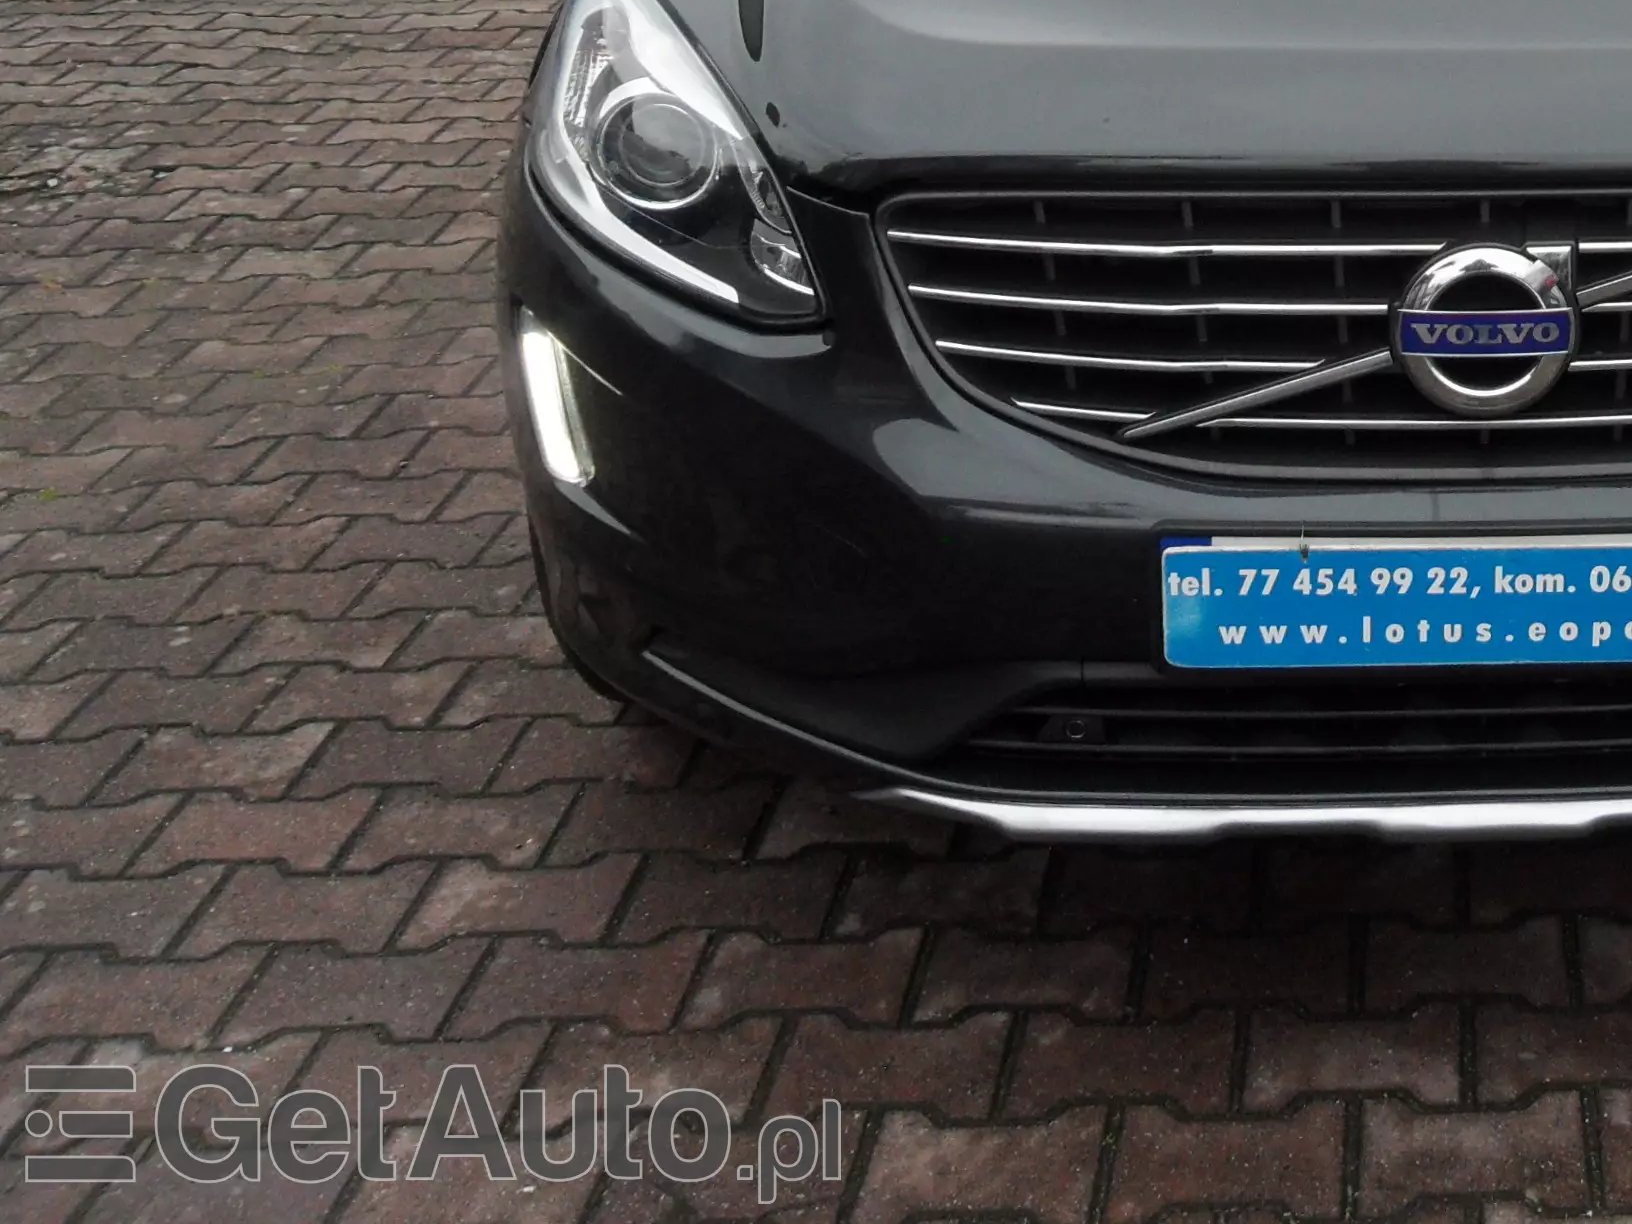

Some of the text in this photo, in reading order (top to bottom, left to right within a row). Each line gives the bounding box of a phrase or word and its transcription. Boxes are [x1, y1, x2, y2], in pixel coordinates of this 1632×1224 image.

[1410, 322, 1560, 345] VOLVO
[1167, 567, 1223, 597] tel.
[1238, 568, 1280, 596] 77
[1292, 568, 1358, 596] 454
[1369, 567, 1413, 595] 99
[1425, 566, 1481, 599] 22,
[1493, 565, 1577, 594] kom.
